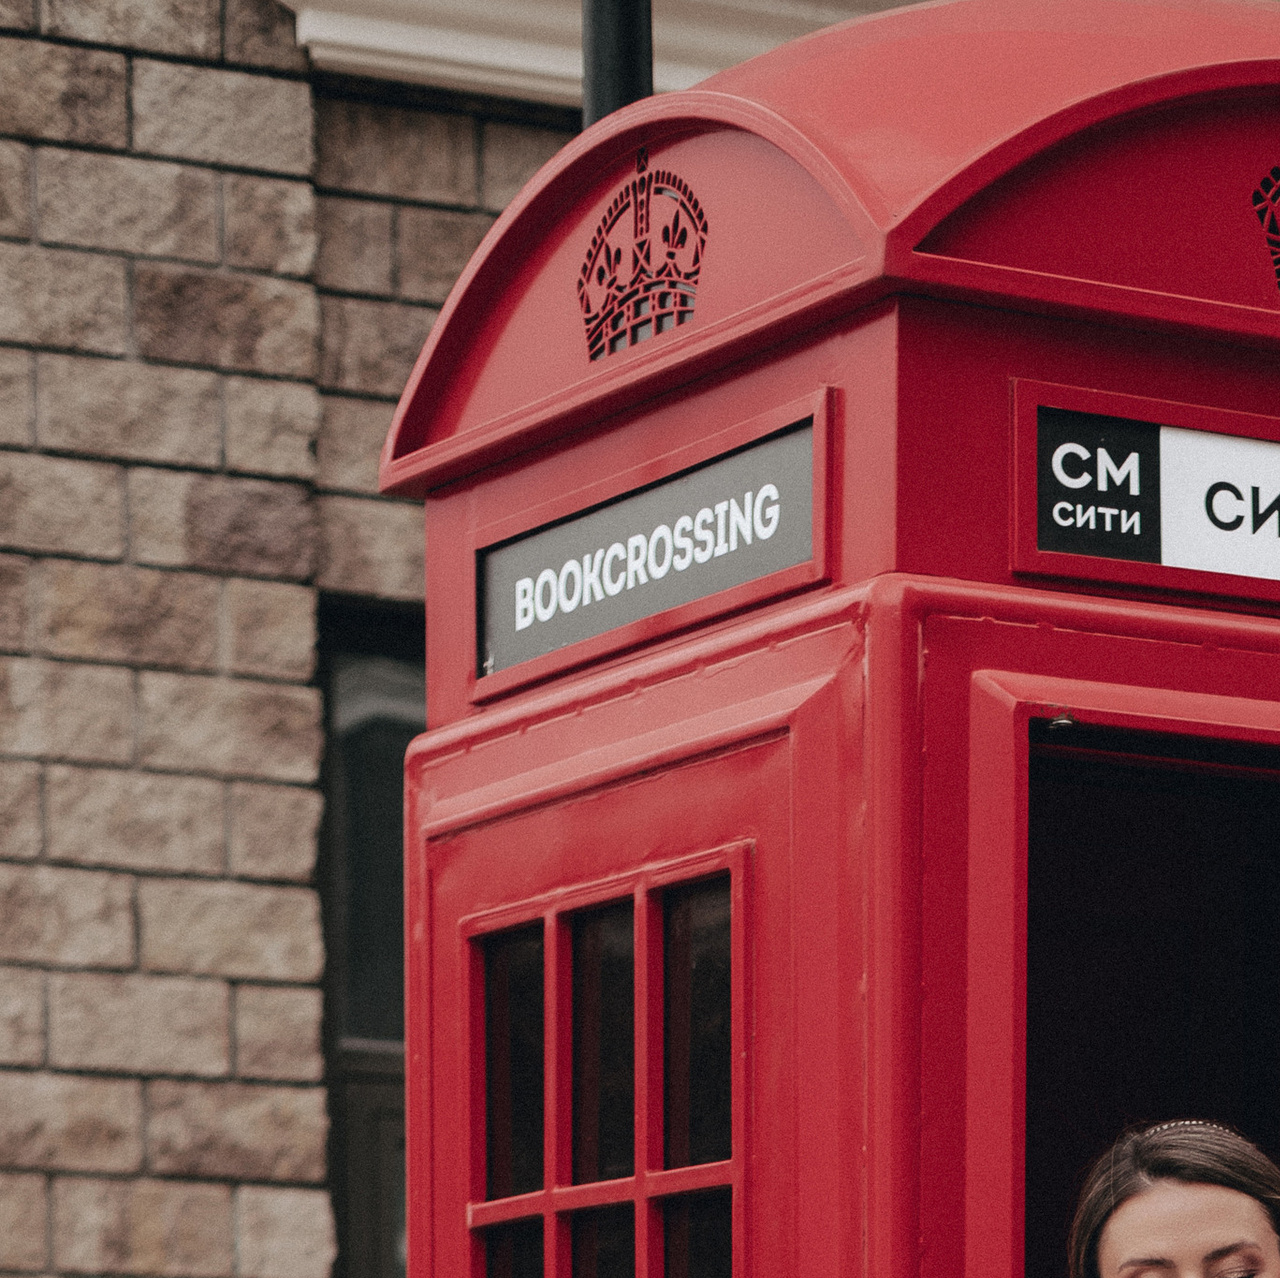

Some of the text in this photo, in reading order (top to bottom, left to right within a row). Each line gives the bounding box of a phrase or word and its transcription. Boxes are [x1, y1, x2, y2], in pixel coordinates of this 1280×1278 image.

[1051, 442, 1140, 496] СМ
[1051, 500, 1141, 536] СИТИ
[514, 482, 781, 632] BOOKCROSSING
